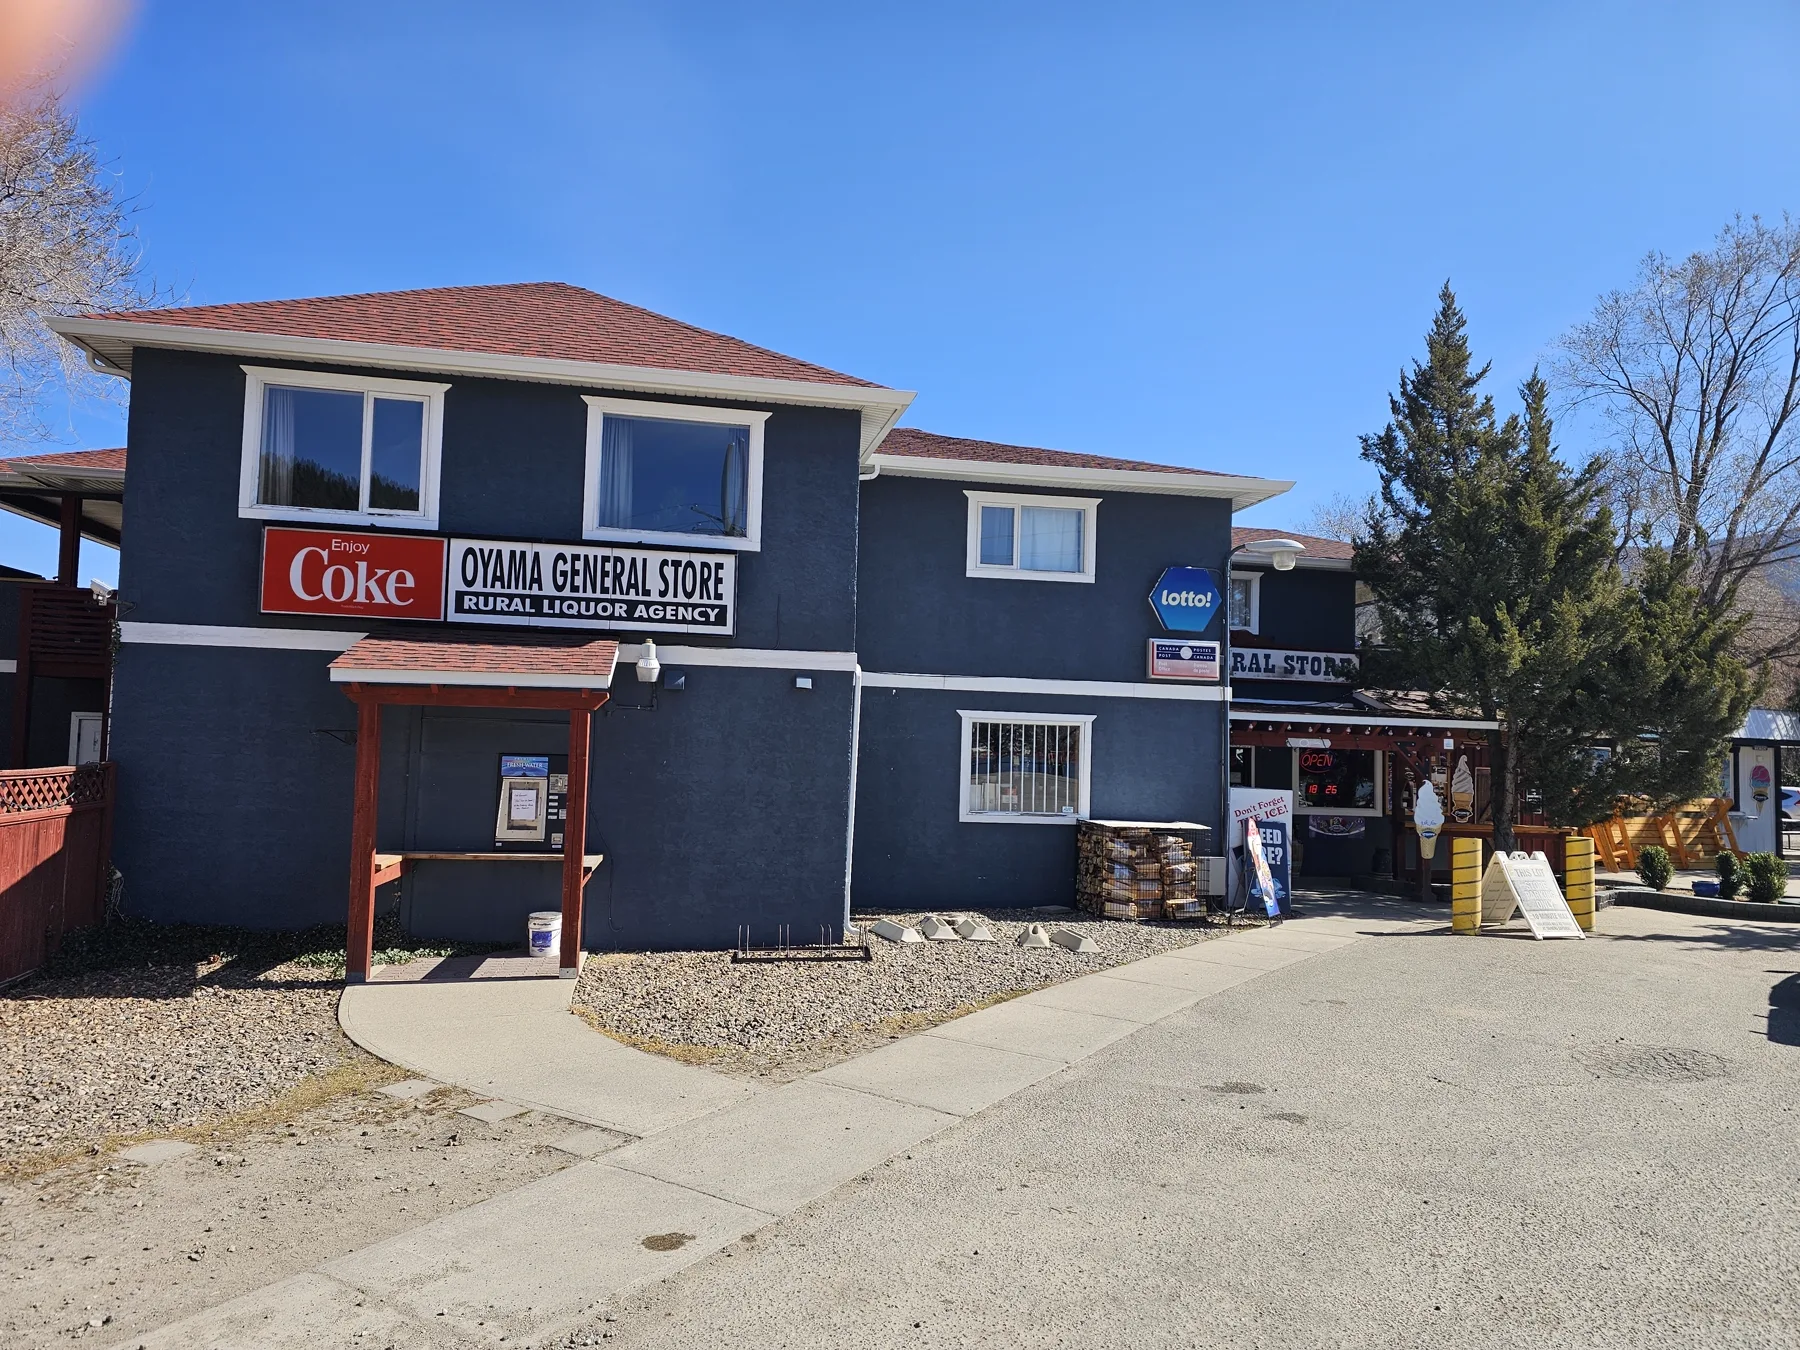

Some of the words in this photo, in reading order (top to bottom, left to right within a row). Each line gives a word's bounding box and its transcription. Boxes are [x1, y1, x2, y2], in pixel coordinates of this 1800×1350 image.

[331, 538, 370, 555] Enjoy
[289, 546, 415, 606] Coke
[461, 546, 543, 591] OYAMA
[552, 552, 651, 597] GENERAL
[658, 558, 724, 600] STORE
[1161, 589, 1212, 608] lotto!
[463, 595, 536, 612] RURAL
[543, 599, 628, 617] LIQUOR
[633, 604, 720, 622] AGENCY
[1301, 754, 1333, 767] OPEN
[1325, 785, 1338, 794] 26
[1234, 805, 1257, 817] Don't
[1257, 796, 1285, 810] Forget
[1264, 804, 1289, 819] ICE!
[1260, 828, 1282, 845] EED
[1514, 868, 1533, 878] THIS
[1531, 868, 1545, 877] LOT
